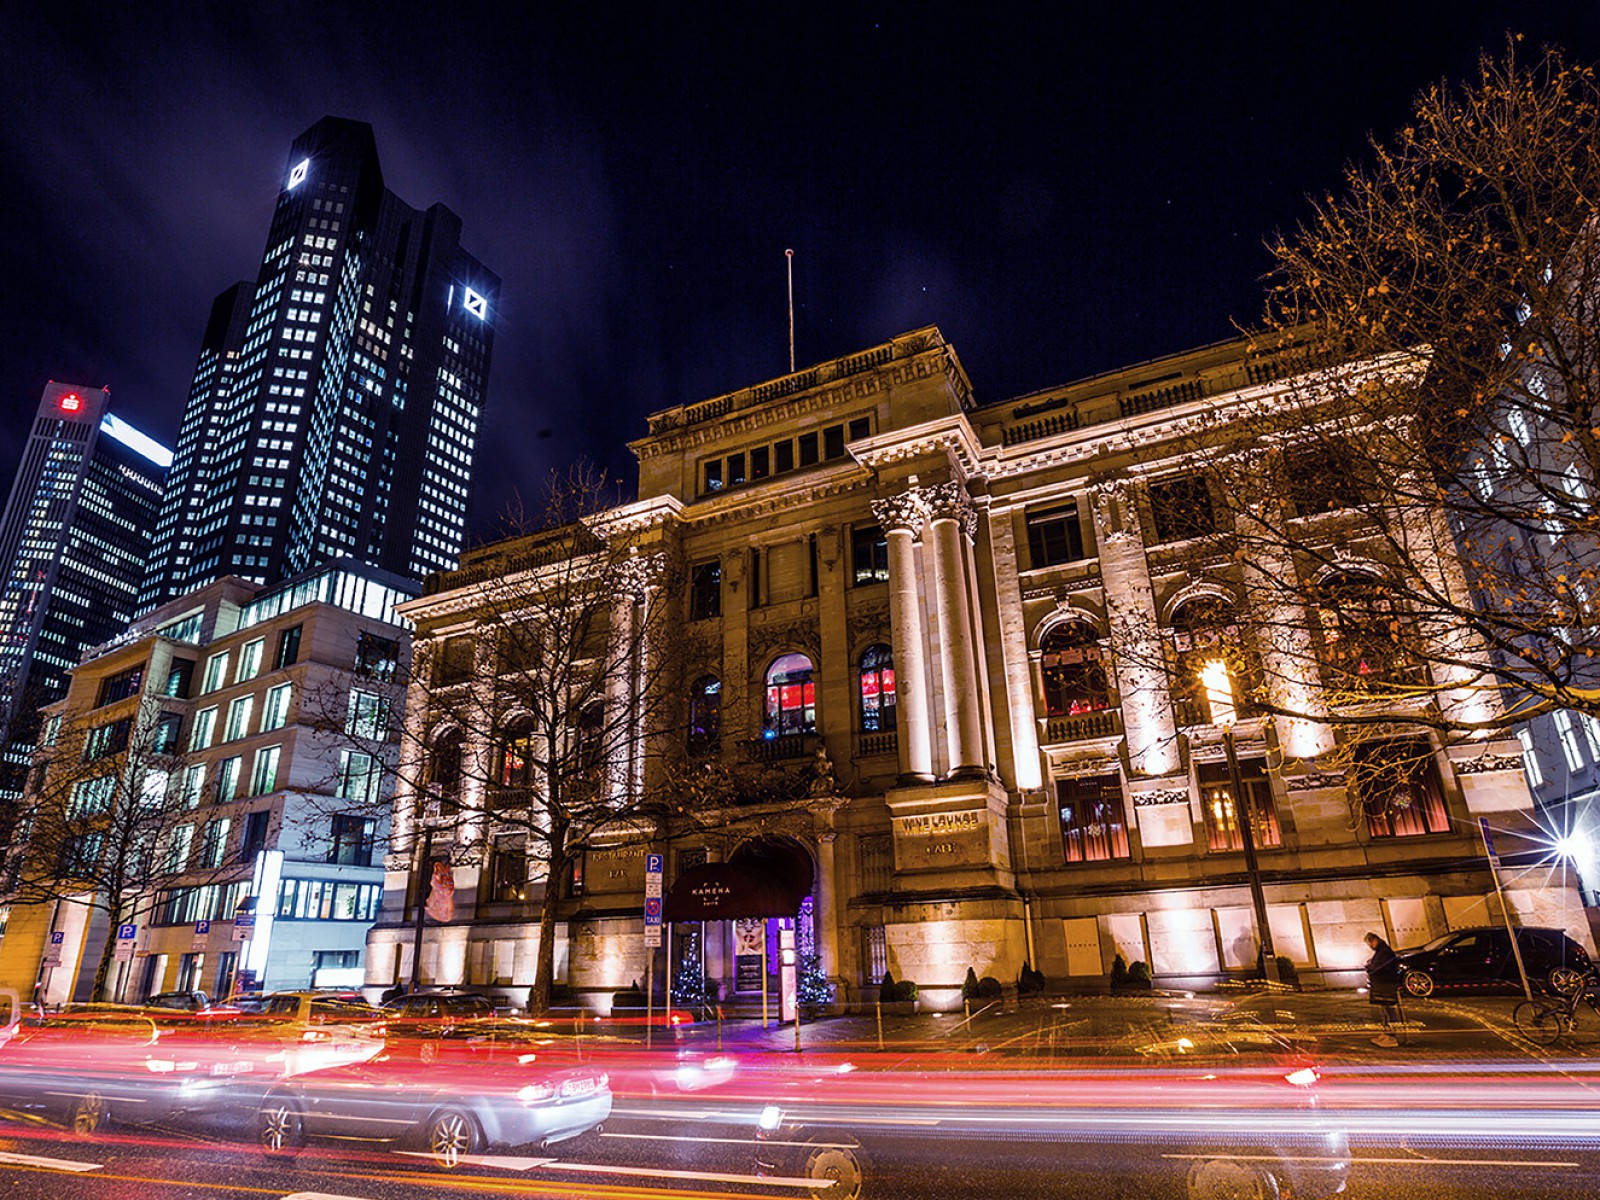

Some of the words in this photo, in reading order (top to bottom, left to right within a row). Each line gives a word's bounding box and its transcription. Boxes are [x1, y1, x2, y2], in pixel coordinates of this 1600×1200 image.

[931, 814, 978, 835] LOUNGE
[592, 849, 645, 862] RESTAURANT
[650, 856, 659, 871] P
[691, 887, 730, 896] KAMEHA
[121, 926, 133, 938] P
[197, 921, 207, 933] P
[53, 932, 62, 942] P
